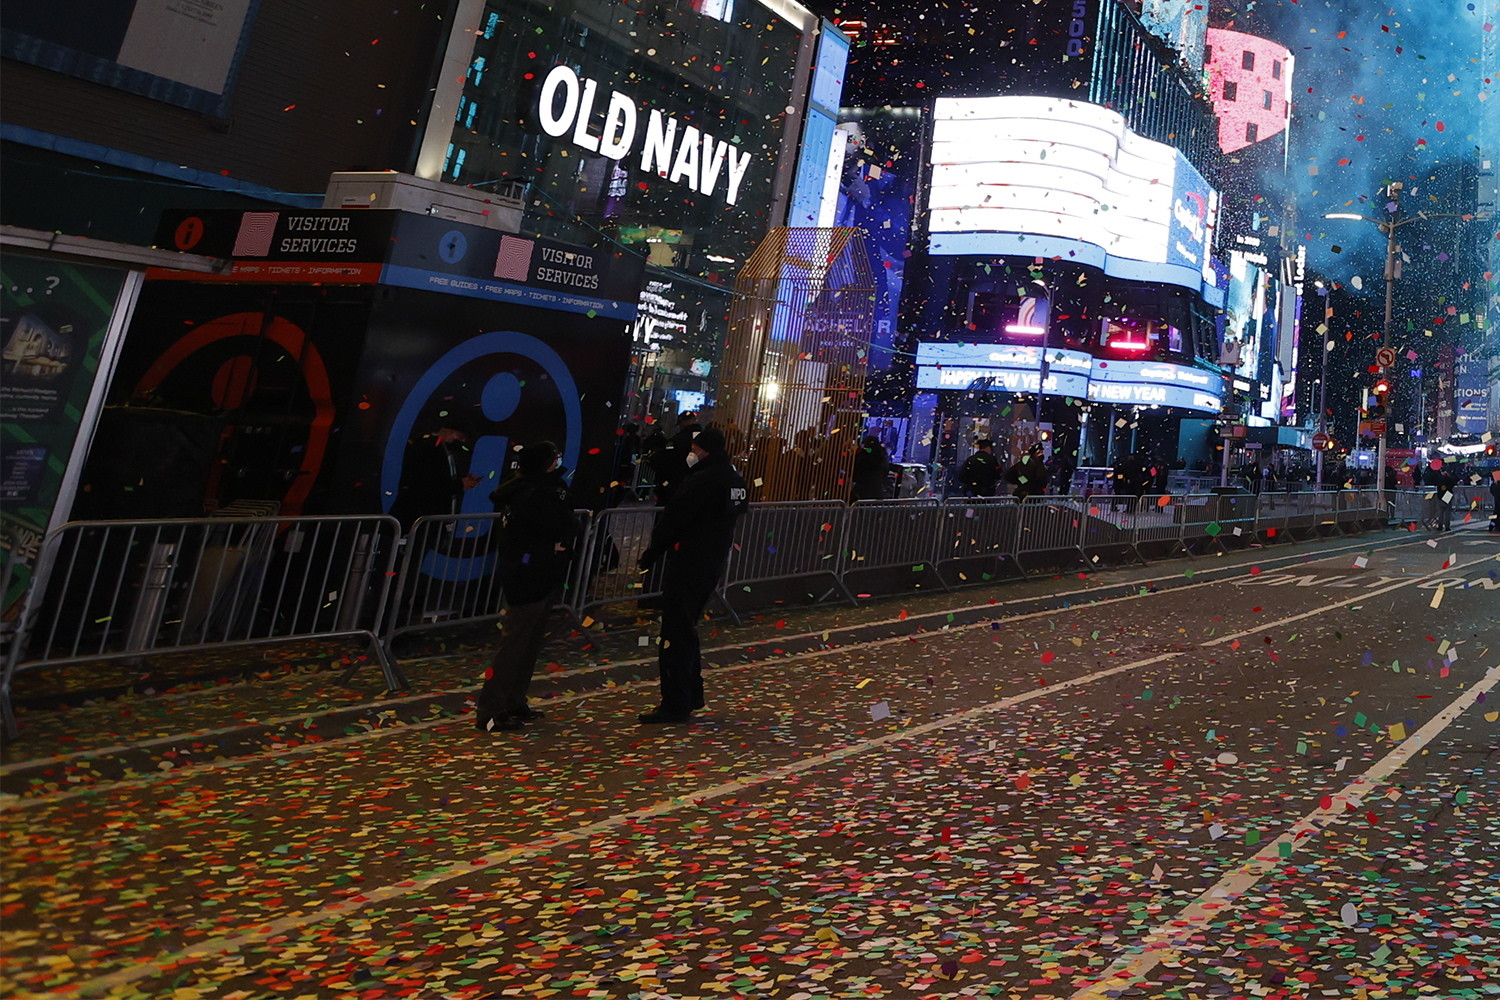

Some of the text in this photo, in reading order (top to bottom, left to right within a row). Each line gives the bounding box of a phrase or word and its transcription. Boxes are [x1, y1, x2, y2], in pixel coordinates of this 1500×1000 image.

[538, 65, 752, 206] OLD NAVY
[287, 216, 350, 231] VISITOR
[280, 238, 357, 253] SERVICES
[541, 248, 593, 269] VISITOR
[429, 276, 449, 286] FREE
[536, 267, 599, 289] SERVICES
[1101, 384, 1130, 399] NEW
[1130, 387, 1166, 401] YEAR
